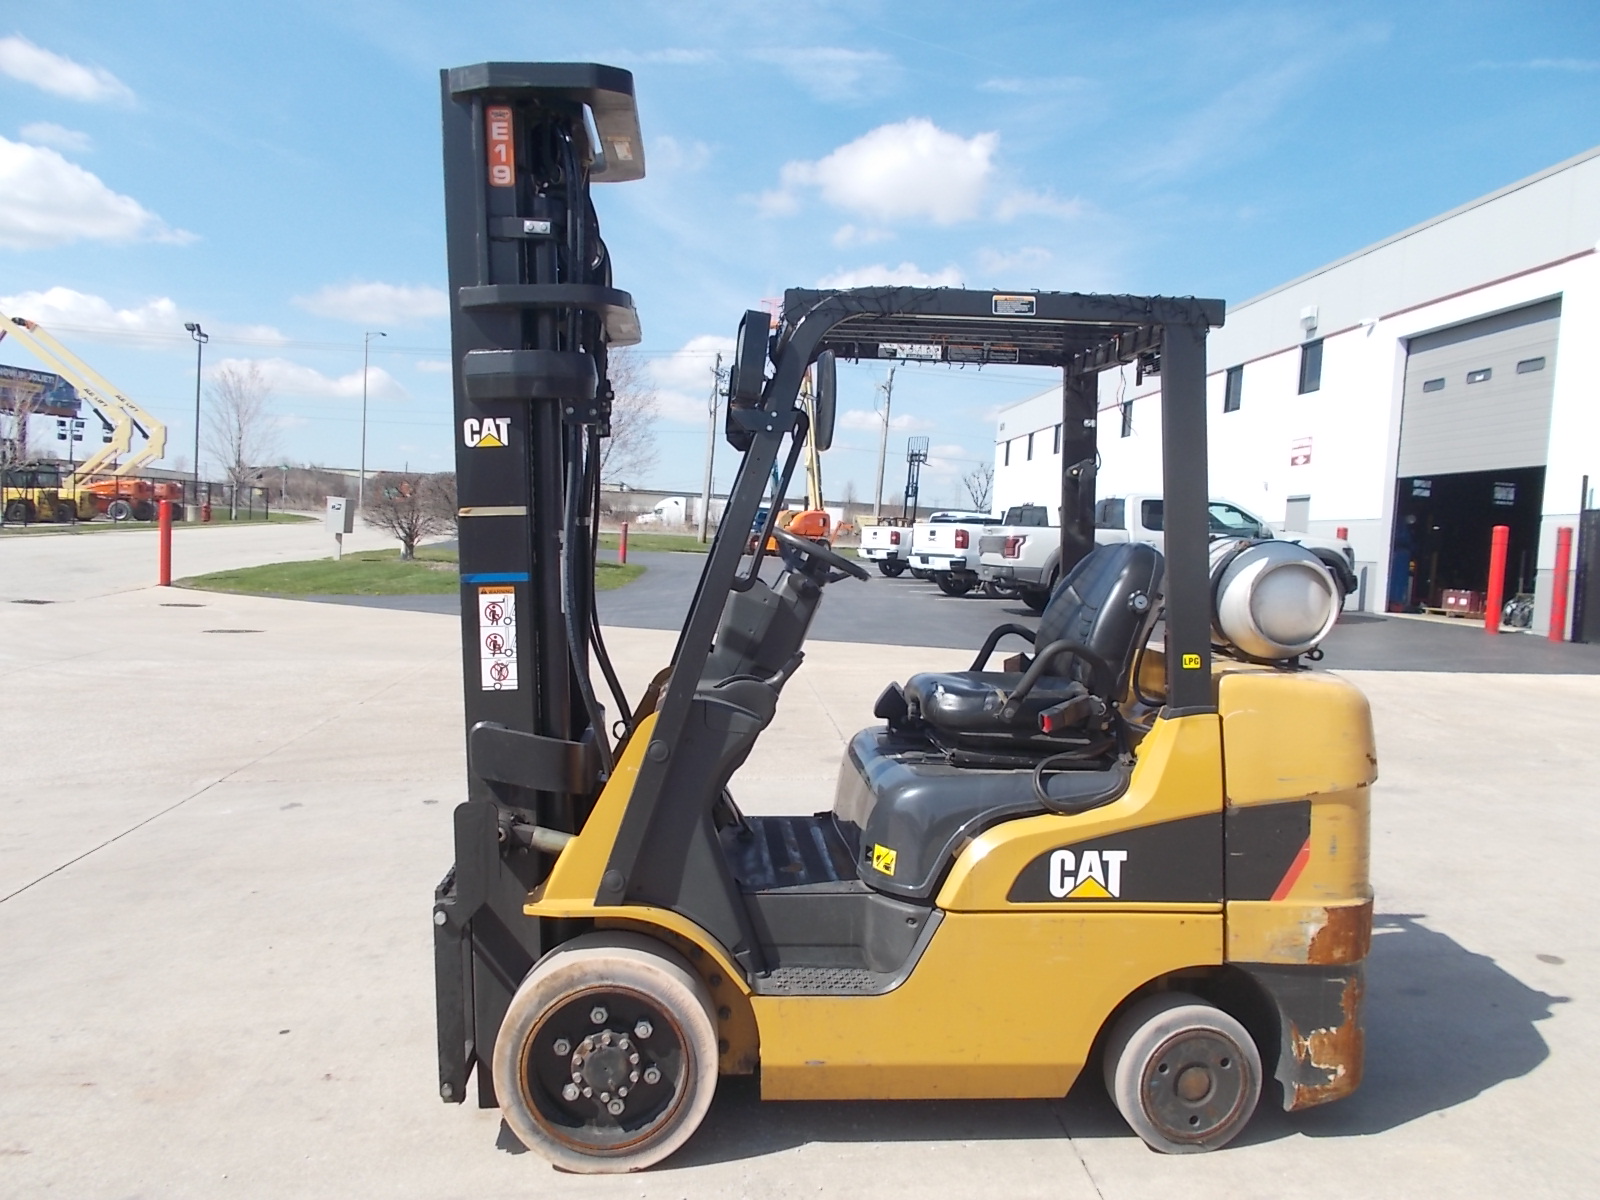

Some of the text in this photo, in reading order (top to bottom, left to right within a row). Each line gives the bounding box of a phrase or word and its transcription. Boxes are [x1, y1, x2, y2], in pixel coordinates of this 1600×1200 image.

[463, 418, 511, 448] CAT
[1183, 656, 1200, 666] LPG
[1049, 849, 1128, 899] CAT
